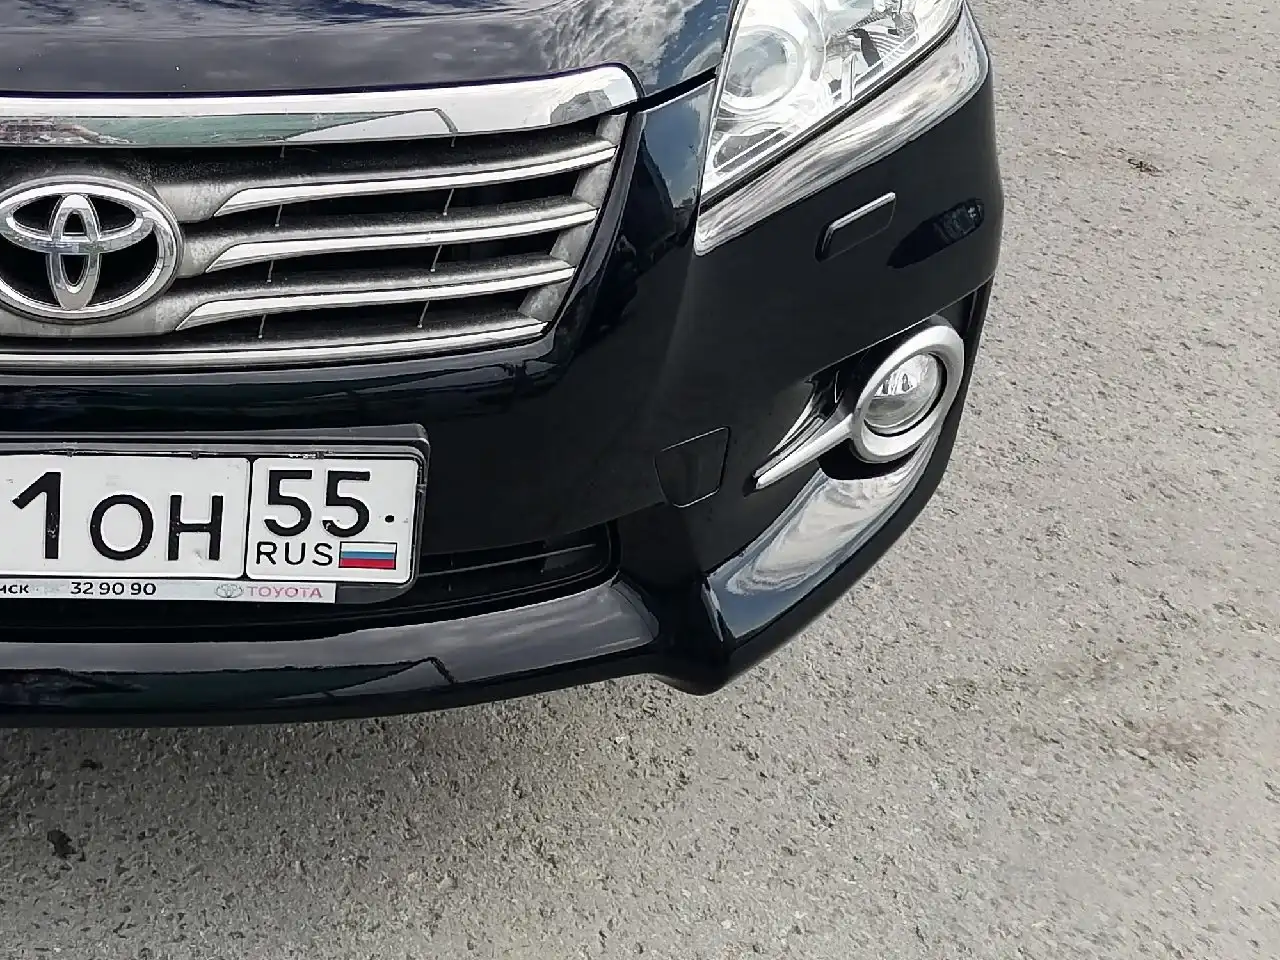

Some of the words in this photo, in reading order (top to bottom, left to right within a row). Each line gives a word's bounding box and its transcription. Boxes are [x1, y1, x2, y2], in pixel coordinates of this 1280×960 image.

[263, 469, 371, 538] 55
[255, 541, 333, 565] RUS
[247, 586, 323, 599] TOYOTA
